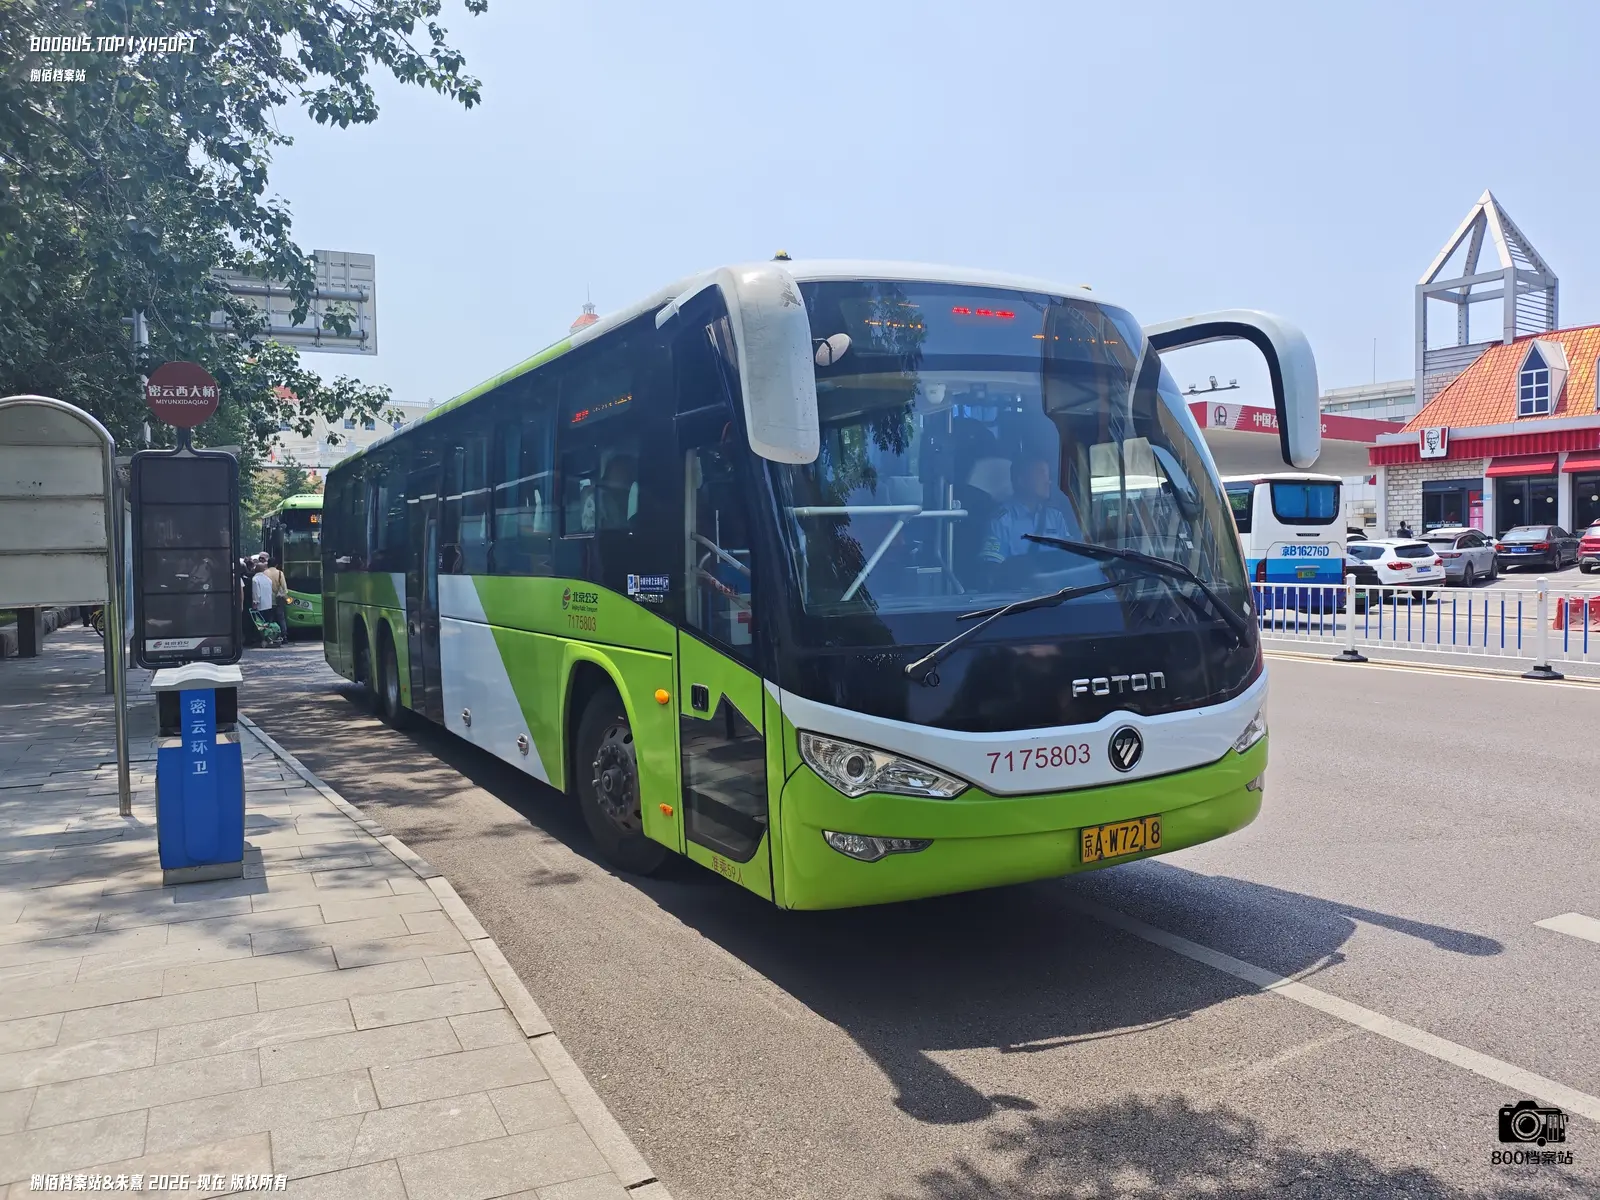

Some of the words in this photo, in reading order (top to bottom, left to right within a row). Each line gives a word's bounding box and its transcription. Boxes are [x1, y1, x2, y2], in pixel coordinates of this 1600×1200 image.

[148, 385, 215, 397] 密云西大桥
[1253, 412, 1280, 428] 中国石
[1281, 545, 1330, 557] 京B16276D
[572, 592, 599, 604] 北京公交
[567, 614, 597, 631] 7175803
[1071, 671, 1166, 697] FOTON
[190, 699, 209, 775] 密云环卫
[987, 743, 1091, 774] 7175803
